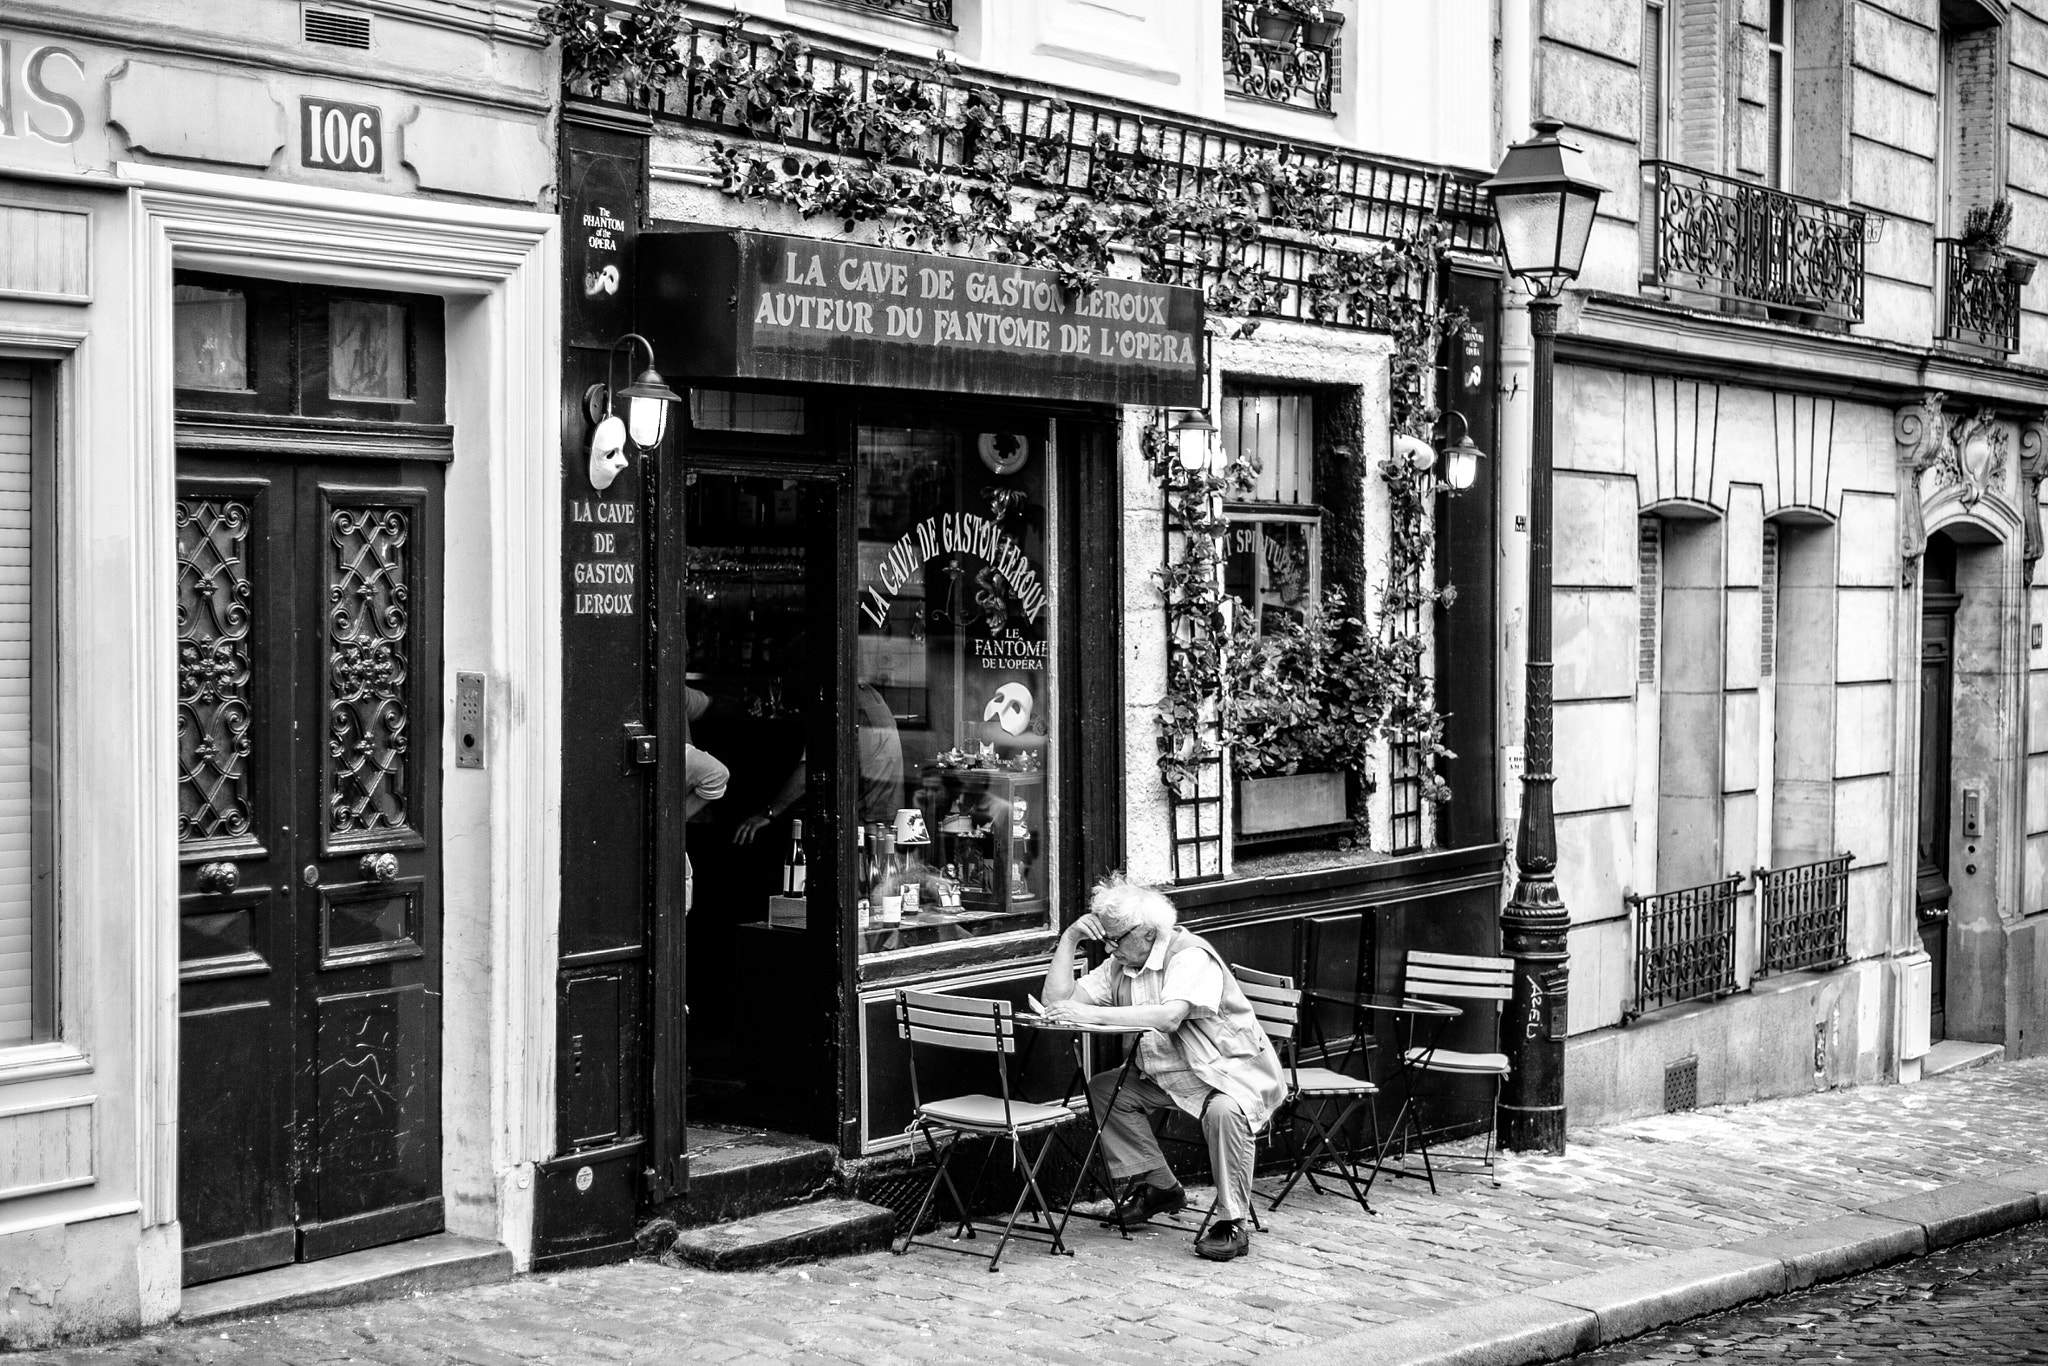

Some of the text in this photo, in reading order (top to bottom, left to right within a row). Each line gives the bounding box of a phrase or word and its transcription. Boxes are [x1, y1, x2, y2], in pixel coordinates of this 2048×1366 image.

[0, 39, 85, 145] S
[308, 105, 375, 168] 106
[583, 214, 624, 231] PHANTOM
[599, 207, 610, 217] The
[589, 236, 616, 250] OPERA
[786, 251, 1166, 325] LA CAVE DE GASTON LEROUX
[755, 292, 1195, 364] AUTEUR DU FANTOME DE L'OPERA
[573, 501, 635, 524] LA CAVE
[594, 532, 615, 553] DE
[574, 563, 635, 585] GASTON
[860, 512, 1049, 628] LA CAVE DE GASTON LEROUX
[575, 593, 634, 615] LEROUX
[1005, 628, 1020, 639] LE
[981, 657, 997, 669] DE
